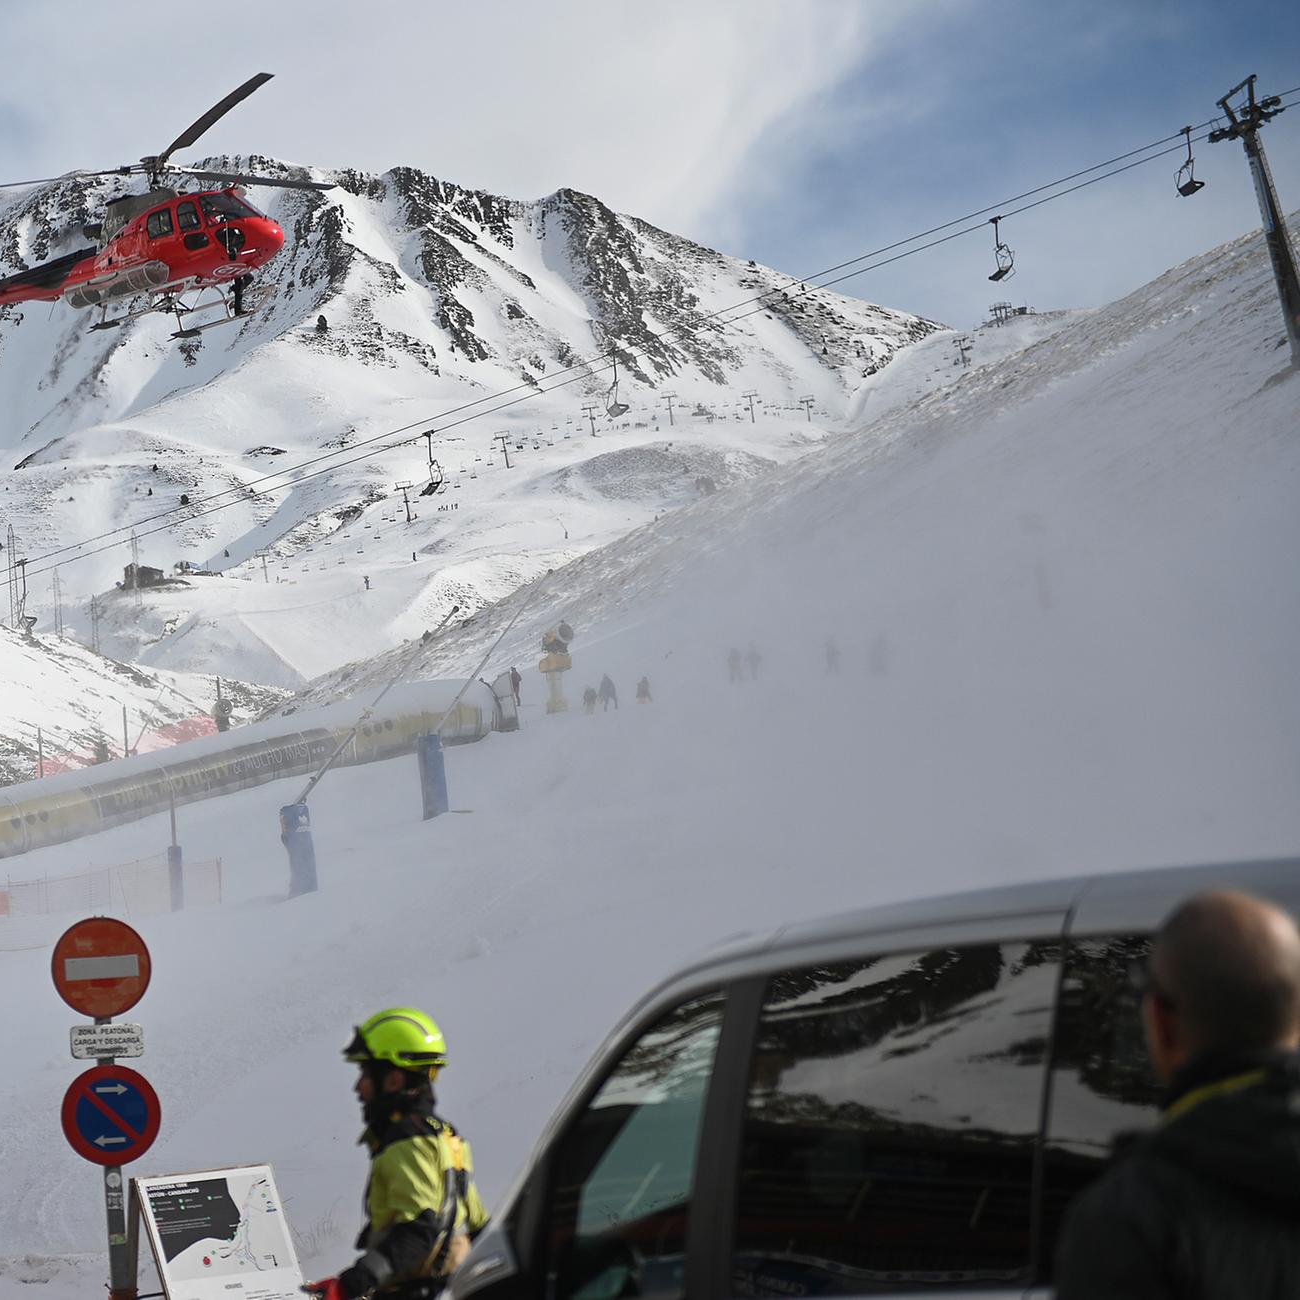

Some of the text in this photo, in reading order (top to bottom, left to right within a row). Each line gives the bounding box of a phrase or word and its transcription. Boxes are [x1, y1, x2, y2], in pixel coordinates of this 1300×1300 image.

[100, 1027, 135, 1035] PEATONAL
[73, 1038, 97, 1046] CARGA
[104, 1036, 140, 1045] DESCARGA
